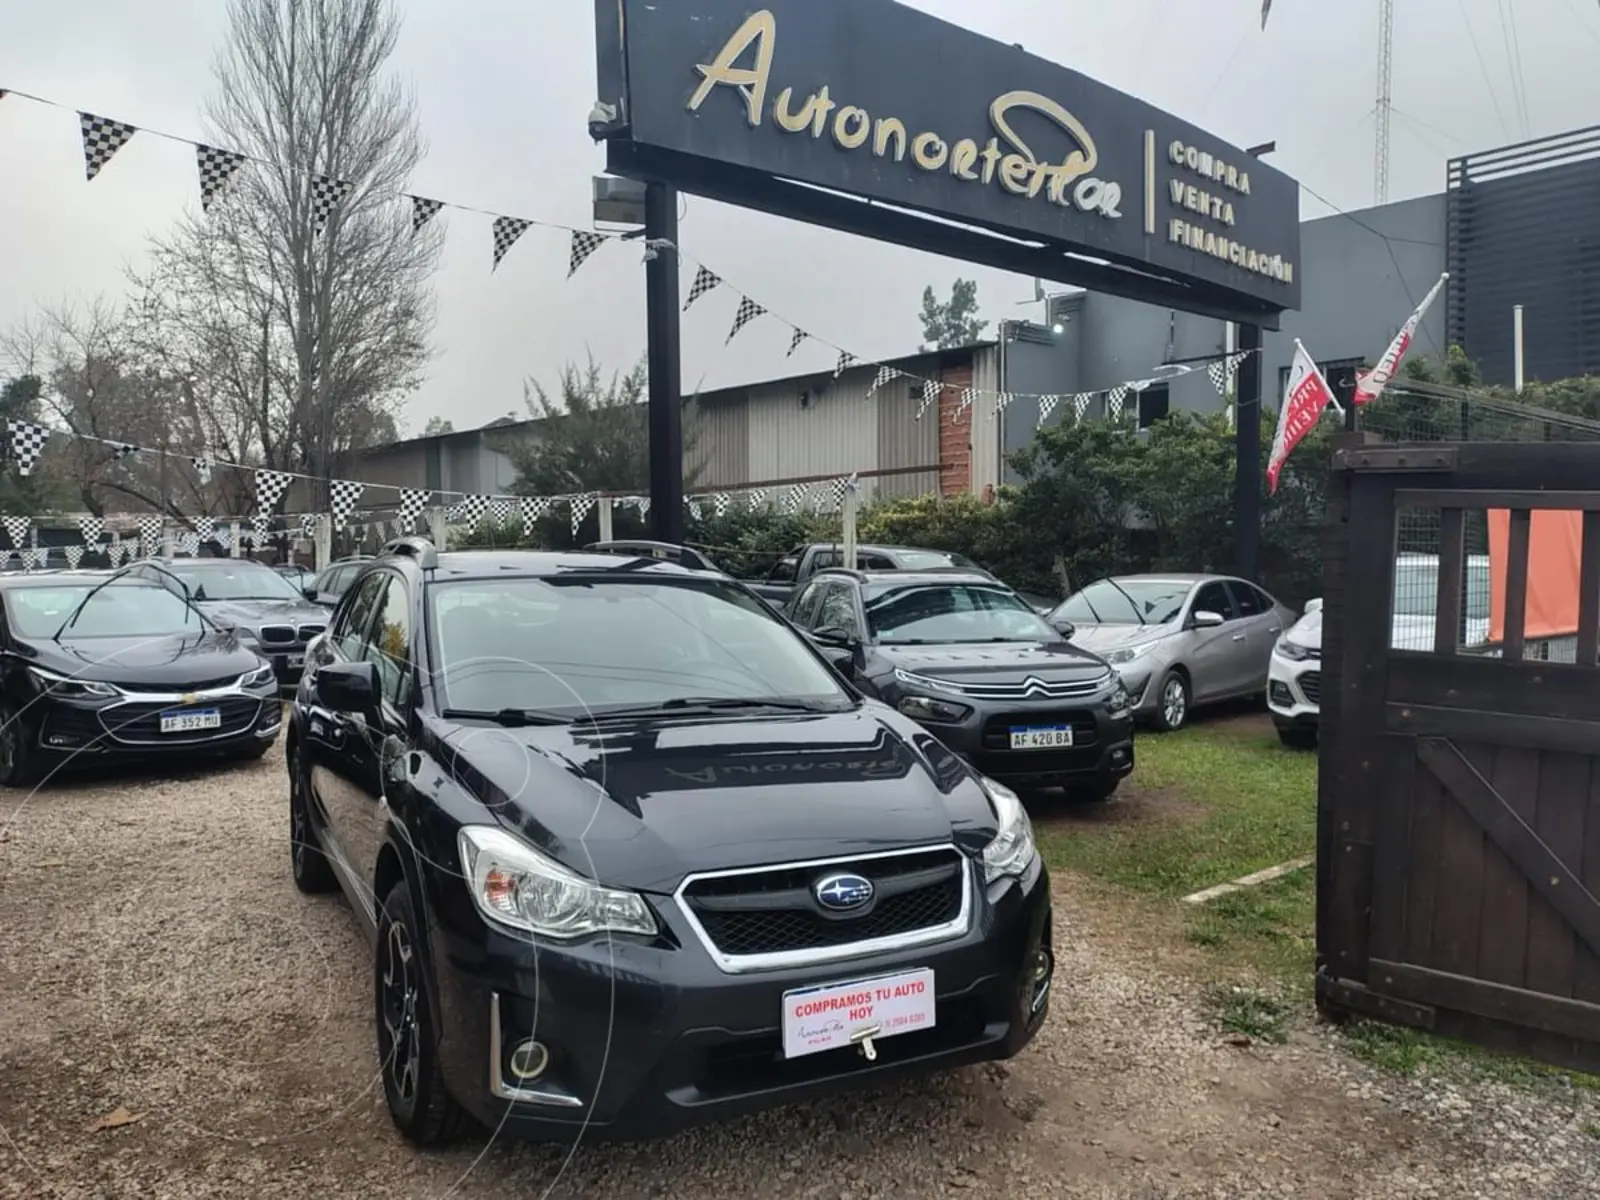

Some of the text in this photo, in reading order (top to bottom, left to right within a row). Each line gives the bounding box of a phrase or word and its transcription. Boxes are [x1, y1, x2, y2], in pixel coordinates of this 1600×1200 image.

[1169, 140, 1251, 195] COMPRA
[1169, 179, 1235, 226] VENTA
[1169, 219, 1293, 284] FINANCIACIÓN
[181, 716, 201, 729] 352
[1014, 731, 1070, 747] AF 420 BA
[795, 981, 926, 1019] COMPRAMOS TU AUTO
[849, 1006, 874, 1022] HOY
